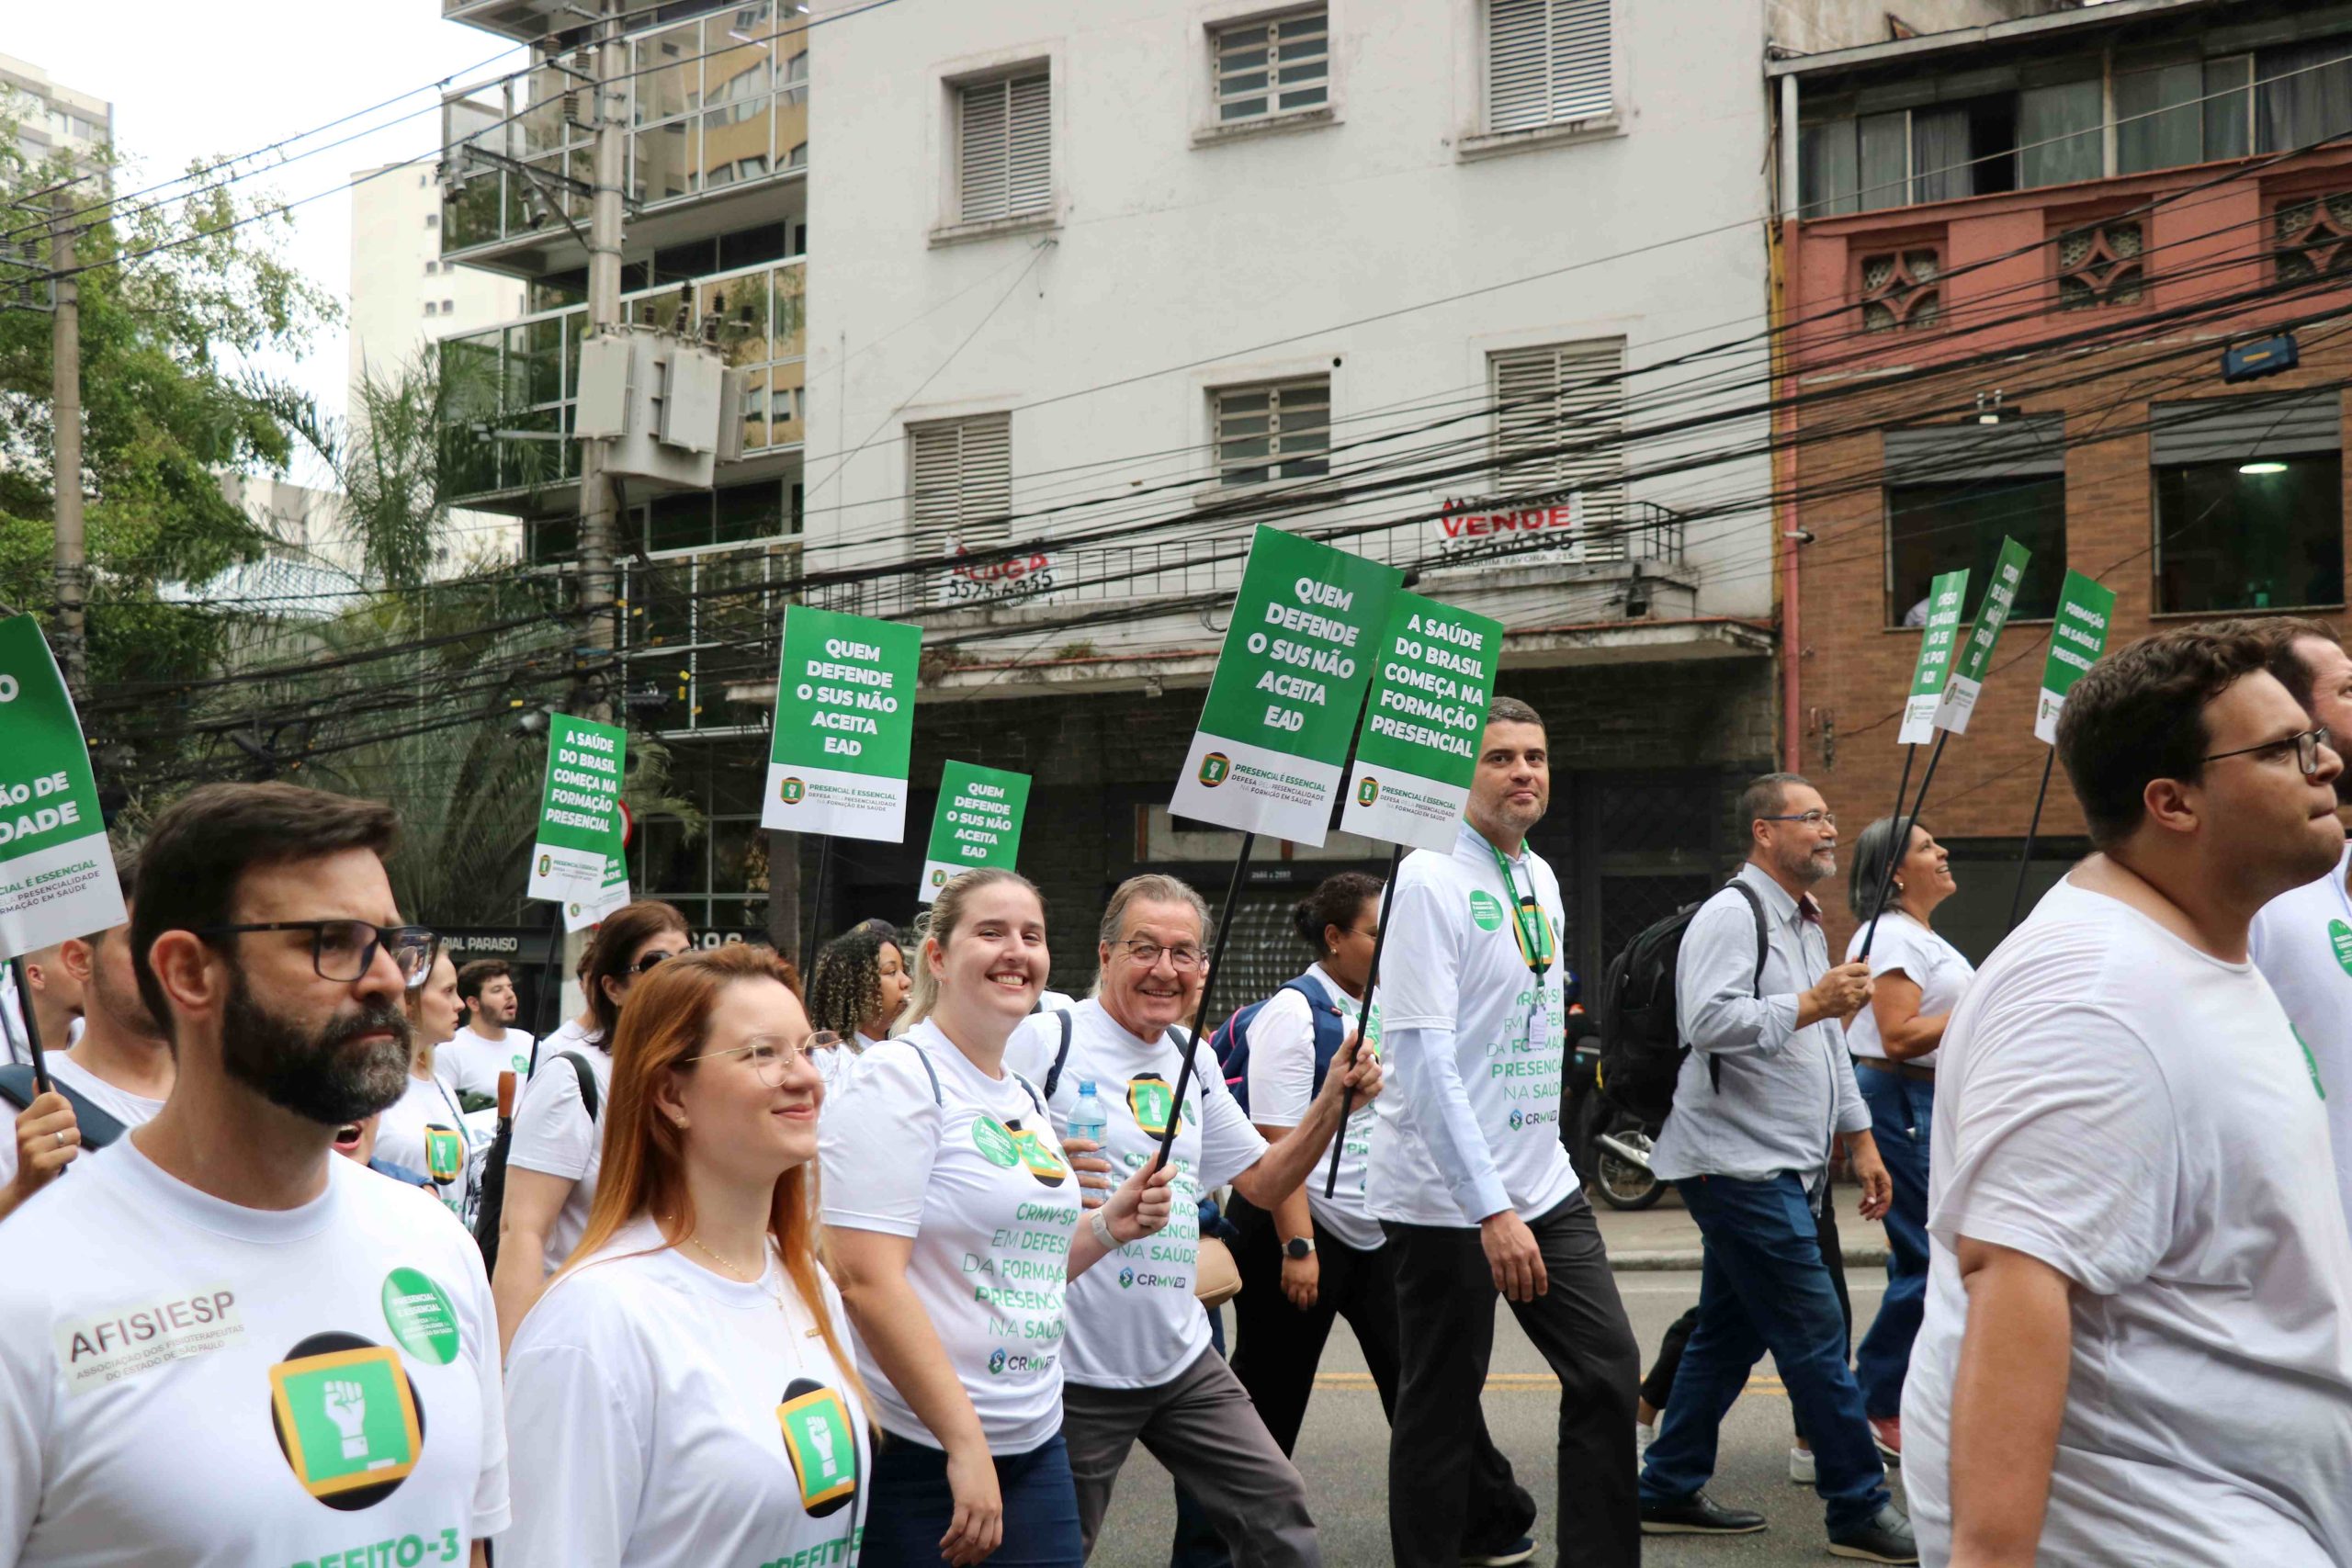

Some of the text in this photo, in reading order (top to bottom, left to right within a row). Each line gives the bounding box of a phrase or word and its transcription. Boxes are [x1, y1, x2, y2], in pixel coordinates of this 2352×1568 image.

[1441, 506, 1572, 538] VENDE
[1294, 576, 1354, 612] QUEM
[1264, 602, 1360, 648] DEFENDE
[2064, 600, 2105, 629] FORMAÇÃO
[1408, 615, 1483, 651] A SAÚDE
[825, 638, 880, 662] QUEM
[1247, 632, 1356, 680] O SUS NÃO
[1395, 637, 1485, 680] DO BRASIL
[807, 660, 893, 688] DEFENDE
[1385, 662, 1484, 707] COMEÇA NA
[797, 684, 898, 713] O SUS NÃO
[1256, 670, 1327, 706] ACEITA
[1263, 705, 1305, 733] EAD
[1380, 689, 1477, 732] FORMAÇÃO
[811, 711, 877, 735] ACEITA
[566, 730, 614, 753] A SAÚDE
[824, 737, 862, 756] EAD
[1371, 714, 1474, 759] PRESENCIAL
[559, 749, 616, 773] DO BRASIL
[35, 770, 70, 799] DE
[553, 768, 616, 794] COMEÇA NA
[1231, 774, 1257, 785] DEFESA
[1235, 764, 1279, 781] PRESENCIAL
[1285, 775, 1327, 792] ESSENCIAL
[551, 789, 613, 813] FORMAÇÃO
[808, 784, 850, 795] PRESENCIAL
[857, 789, 897, 801] ESSENCIAL
[967, 783, 1005, 798] QUEM
[1380, 795, 1400, 804] DEFESA
[1382, 785, 1422, 801] PRESENCIAL
[1427, 796, 1456, 810] ESSENCIAL
[954, 795, 1012, 815] DEFENDE
[546, 808, 610, 832] PRESENCIAL
[946, 810, 1012, 831] O SUS NÃO
[955, 828, 998, 845] ACEITA
[961, 844, 988, 858] EAD
[35, 859, 97, 884] ESSENCIAL
[17, 870, 101, 901] PRESENCIALIDADE
[468, 937, 518, 952] PARAISO
[1487, 1043, 1506, 1057] DA
[1503, 1085, 1530, 1100] NA
[1016, 1202, 1078, 1226] CRMV-SP
[991, 1228, 1019, 1248] EM
[1116, 1244, 1145, 1258] NA
[963, 1253, 995, 1277] DA
[71, 1290, 235, 1364] AFISIESP
[989, 1316, 1020, 1338] NA
[76, 1324, 245, 1380] ASSOCIAÇÃO DOS FISIOTERAPEUTAS
[106, 1339, 226, 1382] DO ESTADO DE SÃO PAULO
